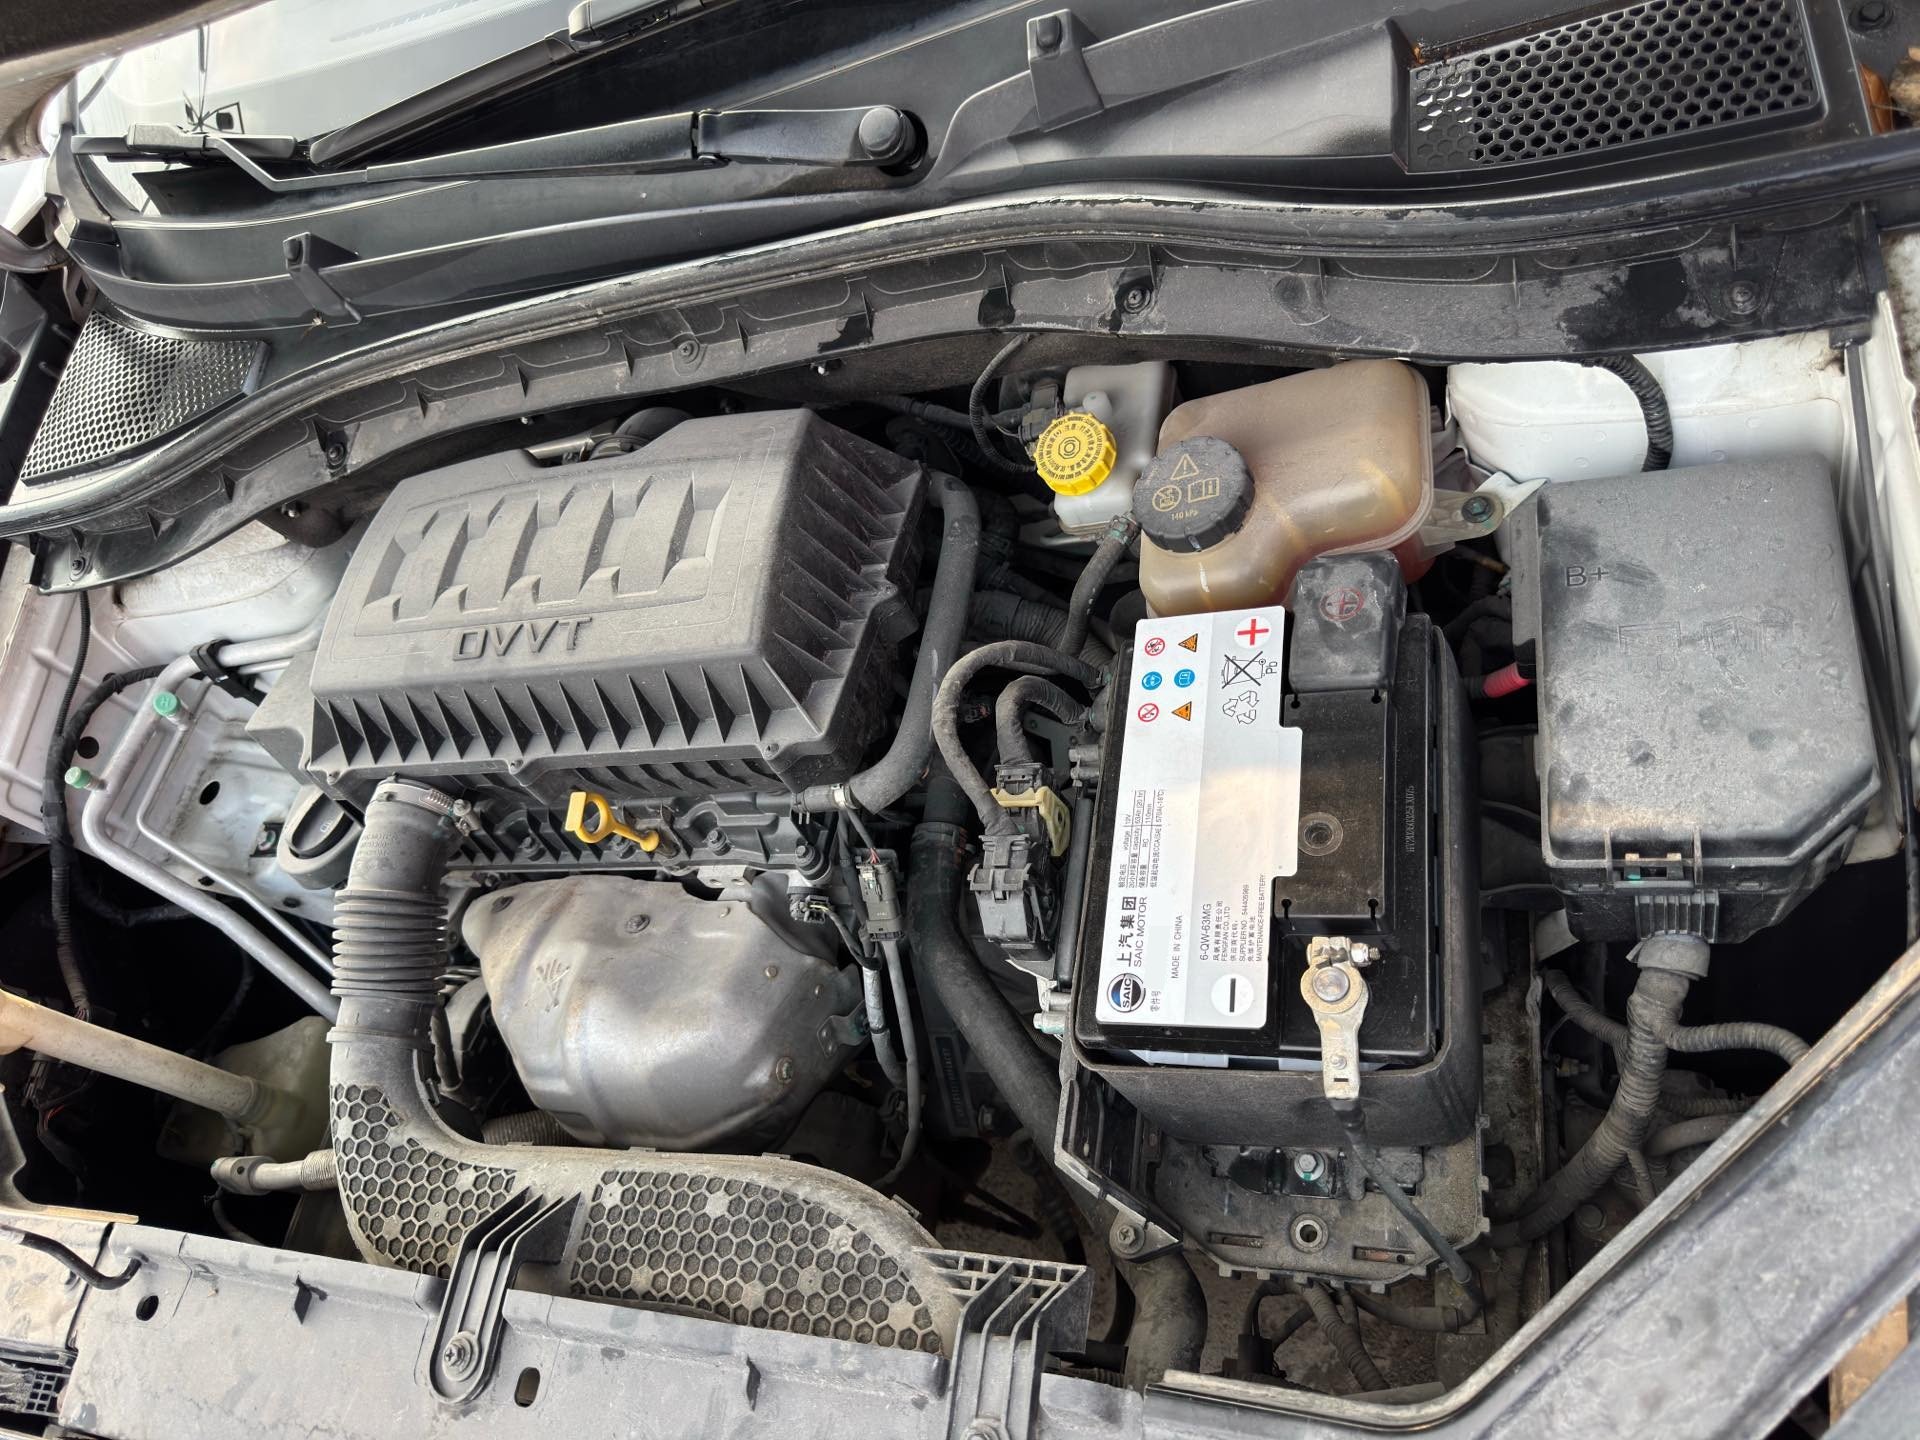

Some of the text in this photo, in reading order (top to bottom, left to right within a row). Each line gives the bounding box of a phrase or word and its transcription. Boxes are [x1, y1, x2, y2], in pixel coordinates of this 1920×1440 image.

[1171, 511, 1184, 521] 140
[1566, 566, 1609, 587] B+
[453, 617, 593, 661] DVVT
[1265, 661, 1278, 675] Pb
[1133, 827, 1141, 850] capacity
[1117, 896, 1136, 967] 上汽集团
[1134, 896, 1148, 967] SAIC MOTOR
[1199, 903, 1212, 961] 6-QW-63MG
[1239, 931, 1247, 961] SUPPLIER
[1171, 915, 1183, 979] MADE IN CHINA
[1122, 978, 1132, 1008] SAIC
